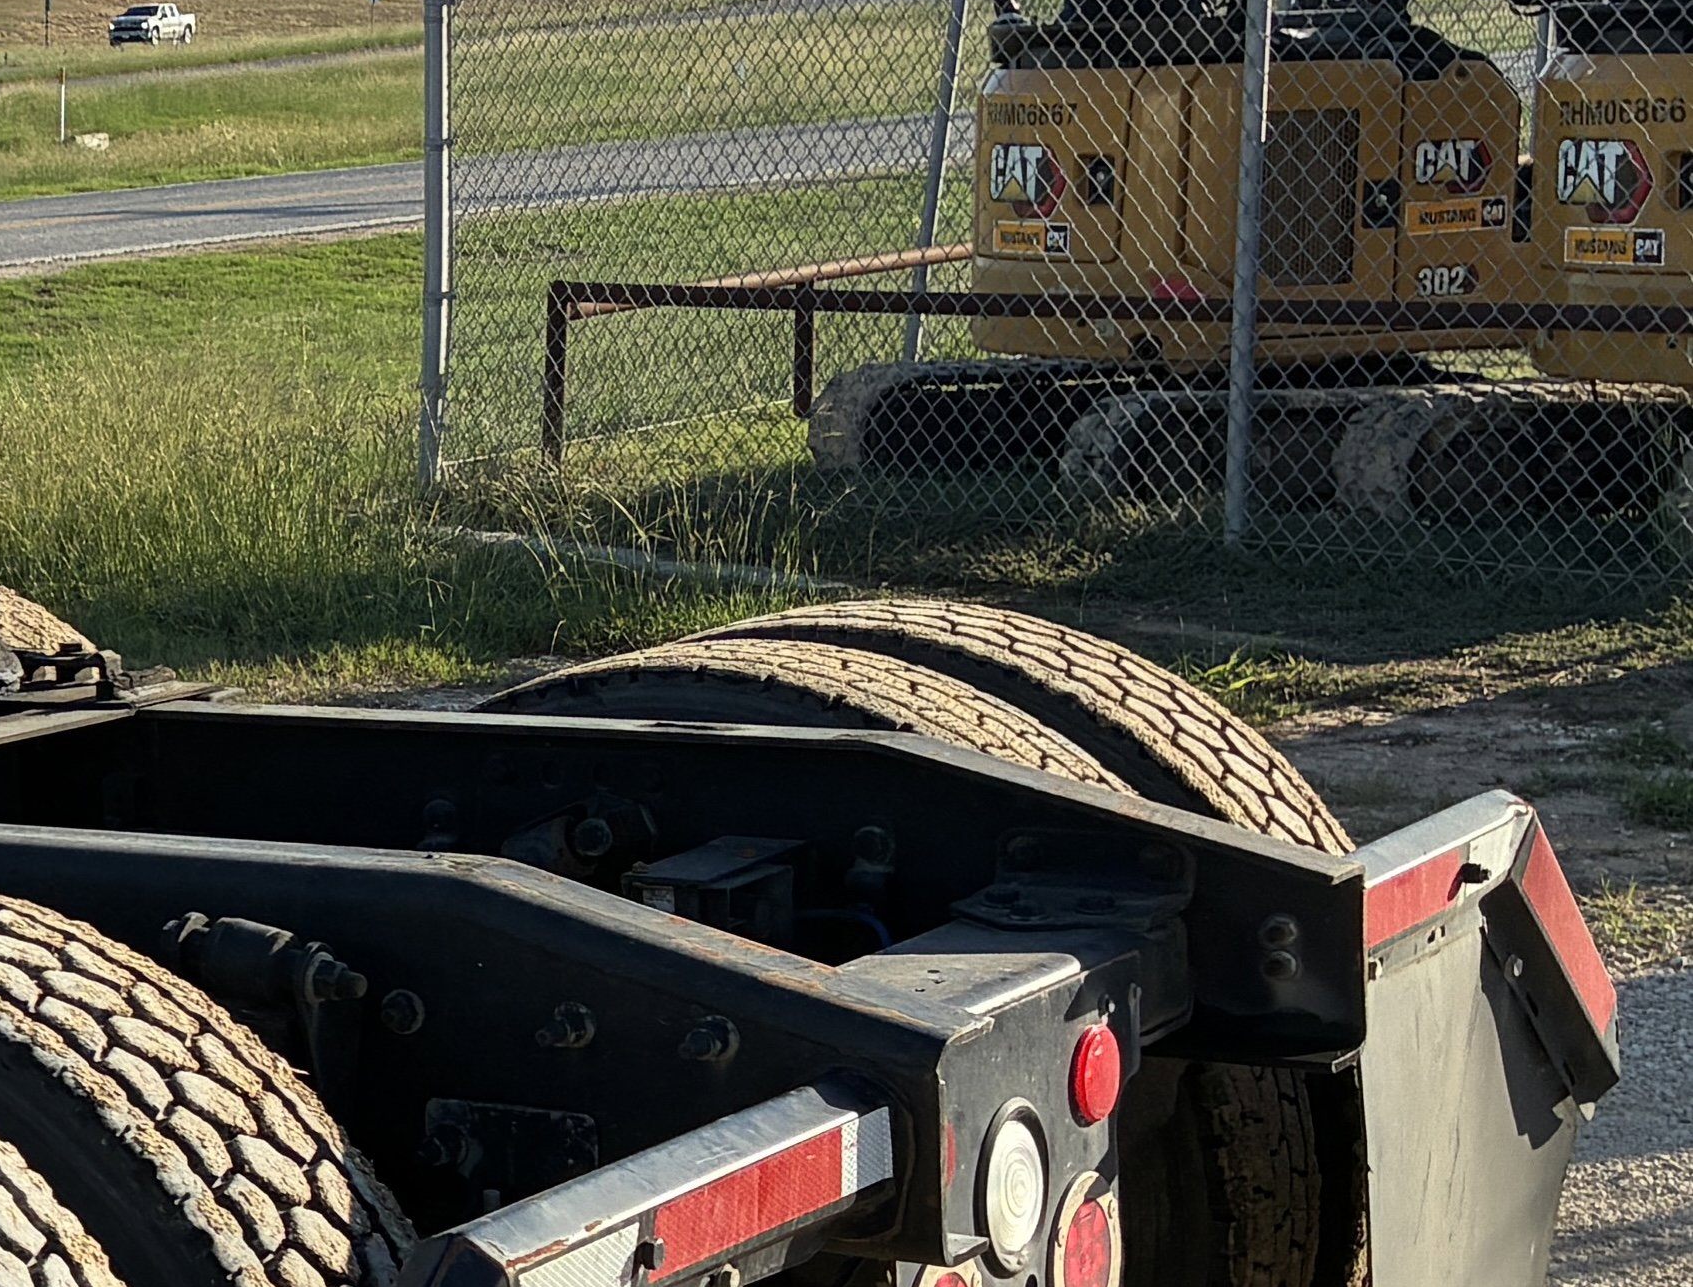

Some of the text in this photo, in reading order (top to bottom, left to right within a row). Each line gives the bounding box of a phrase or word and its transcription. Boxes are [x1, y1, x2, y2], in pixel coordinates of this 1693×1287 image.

[990, 144, 1043, 202] CAT
[1415, 140, 1476, 183] CAT
[1557, 139, 1625, 205] CAT
[1419, 208, 1477, 225] MUSTANG
[1635, 238, 1659, 256] CAT
[1418, 266, 1465, 296] 302
